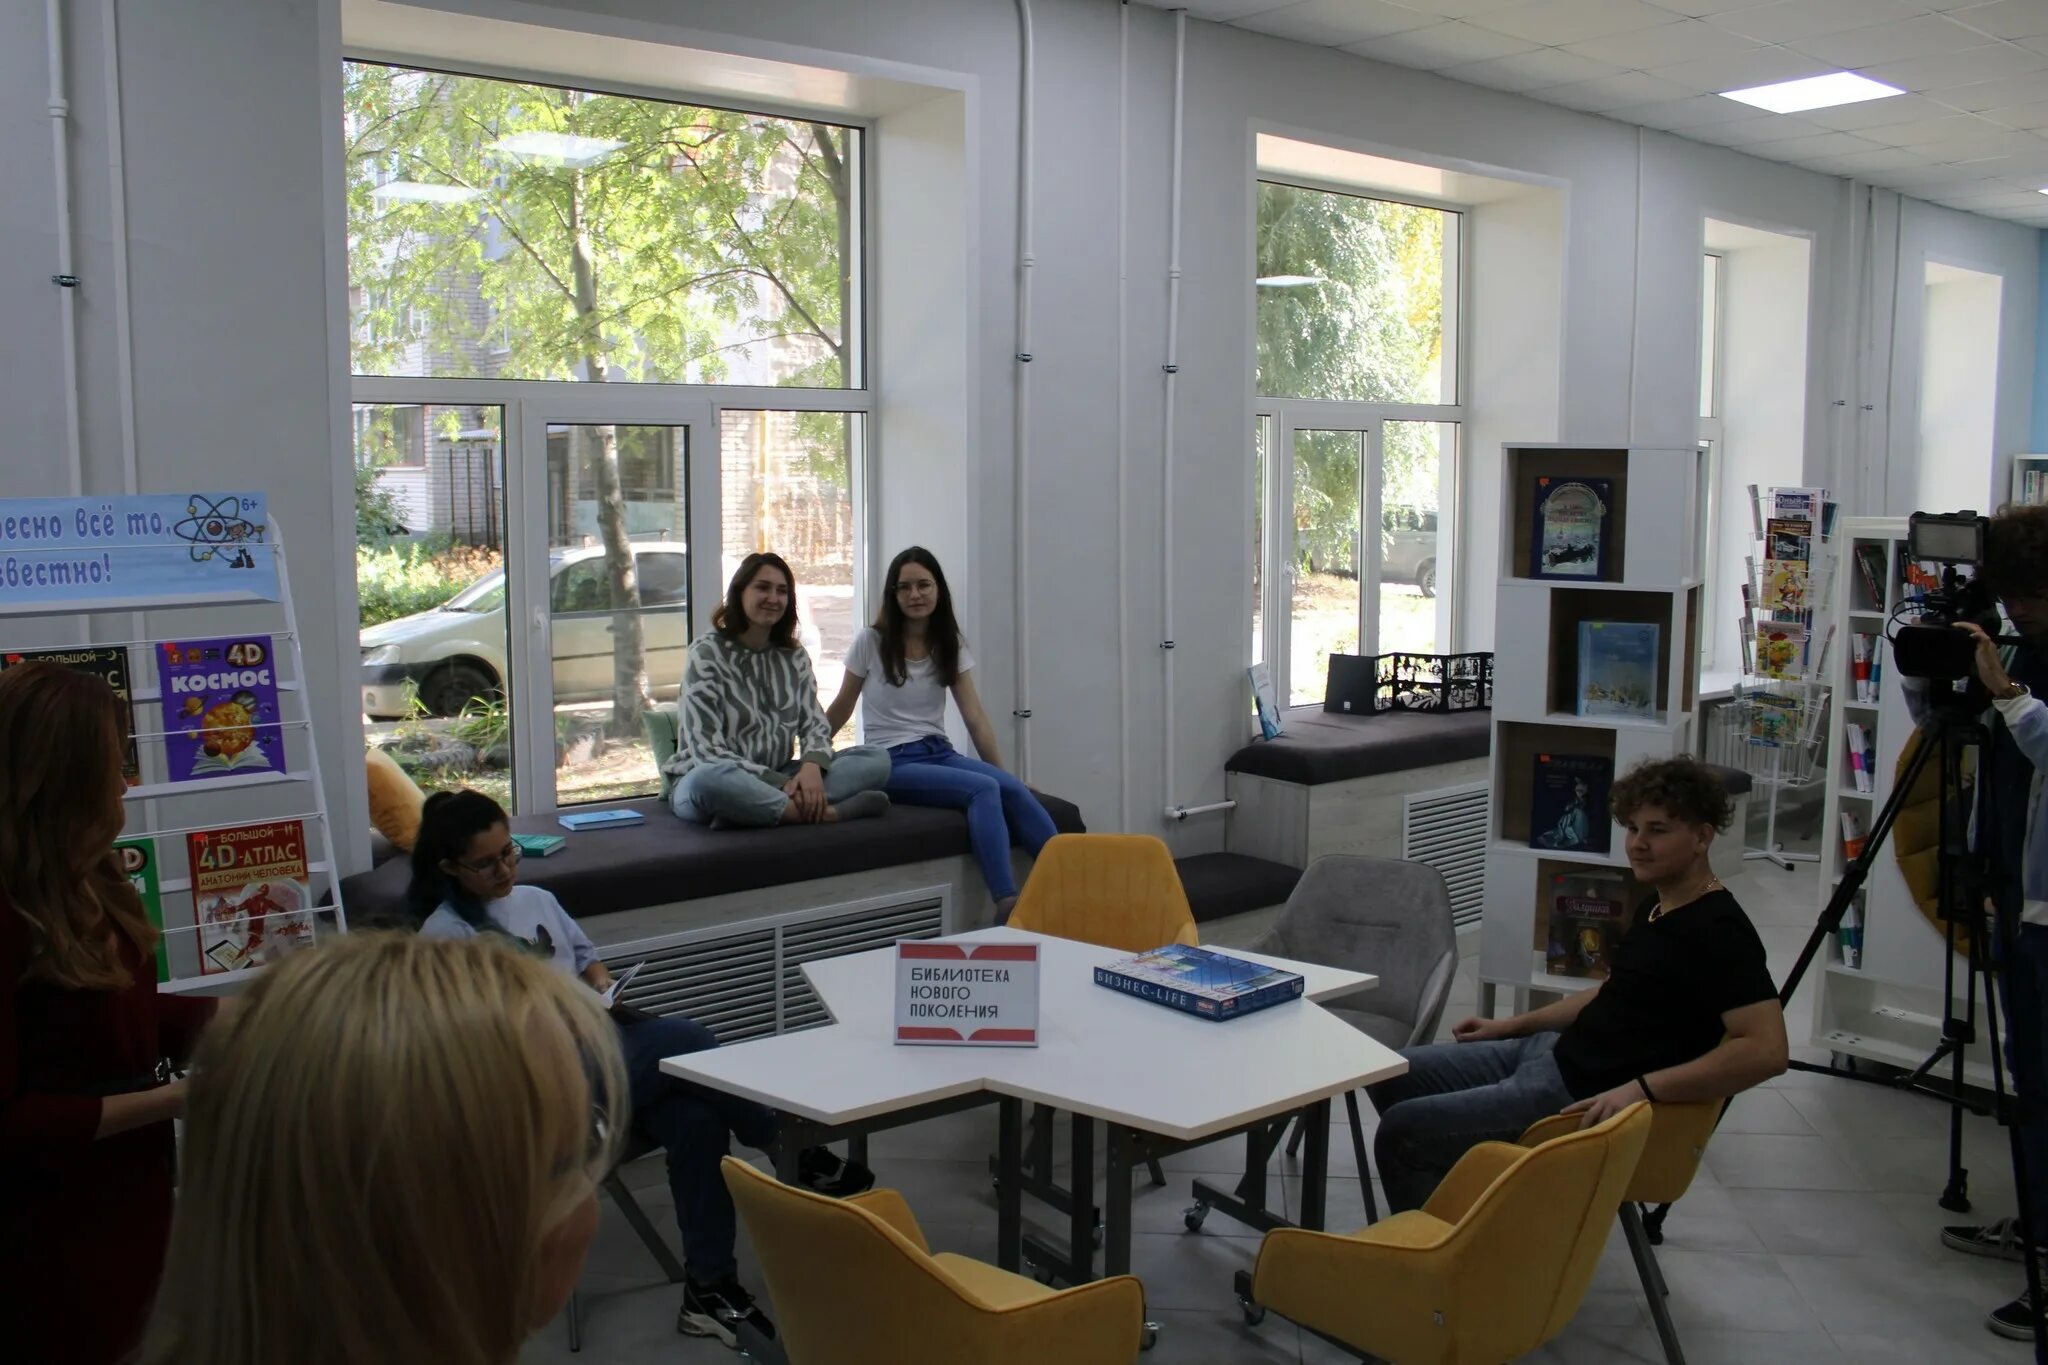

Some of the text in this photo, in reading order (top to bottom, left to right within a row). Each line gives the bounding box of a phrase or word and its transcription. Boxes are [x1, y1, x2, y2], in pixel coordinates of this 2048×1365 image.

[241, 498, 258, 512] 6+
[75, 504, 115, 538] всё
[227, 643, 265, 666] 4D
[171, 669, 271, 693] КОСМОС
[220, 826, 274, 843] БОЛЬШОЙ
[120, 847, 145, 871] D
[200, 864, 303, 887] АНАТОМИИ ЧЕЛОВЕКА
[911, 967, 1010, 983] БИБЛИОТЕКА
[911, 985, 971, 1000] НОВОГО
[1096, 971, 1188, 1007] БИЗНЕС-LIFE
[910, 1003, 999, 1019] ПОКОЛЕНИЯ
